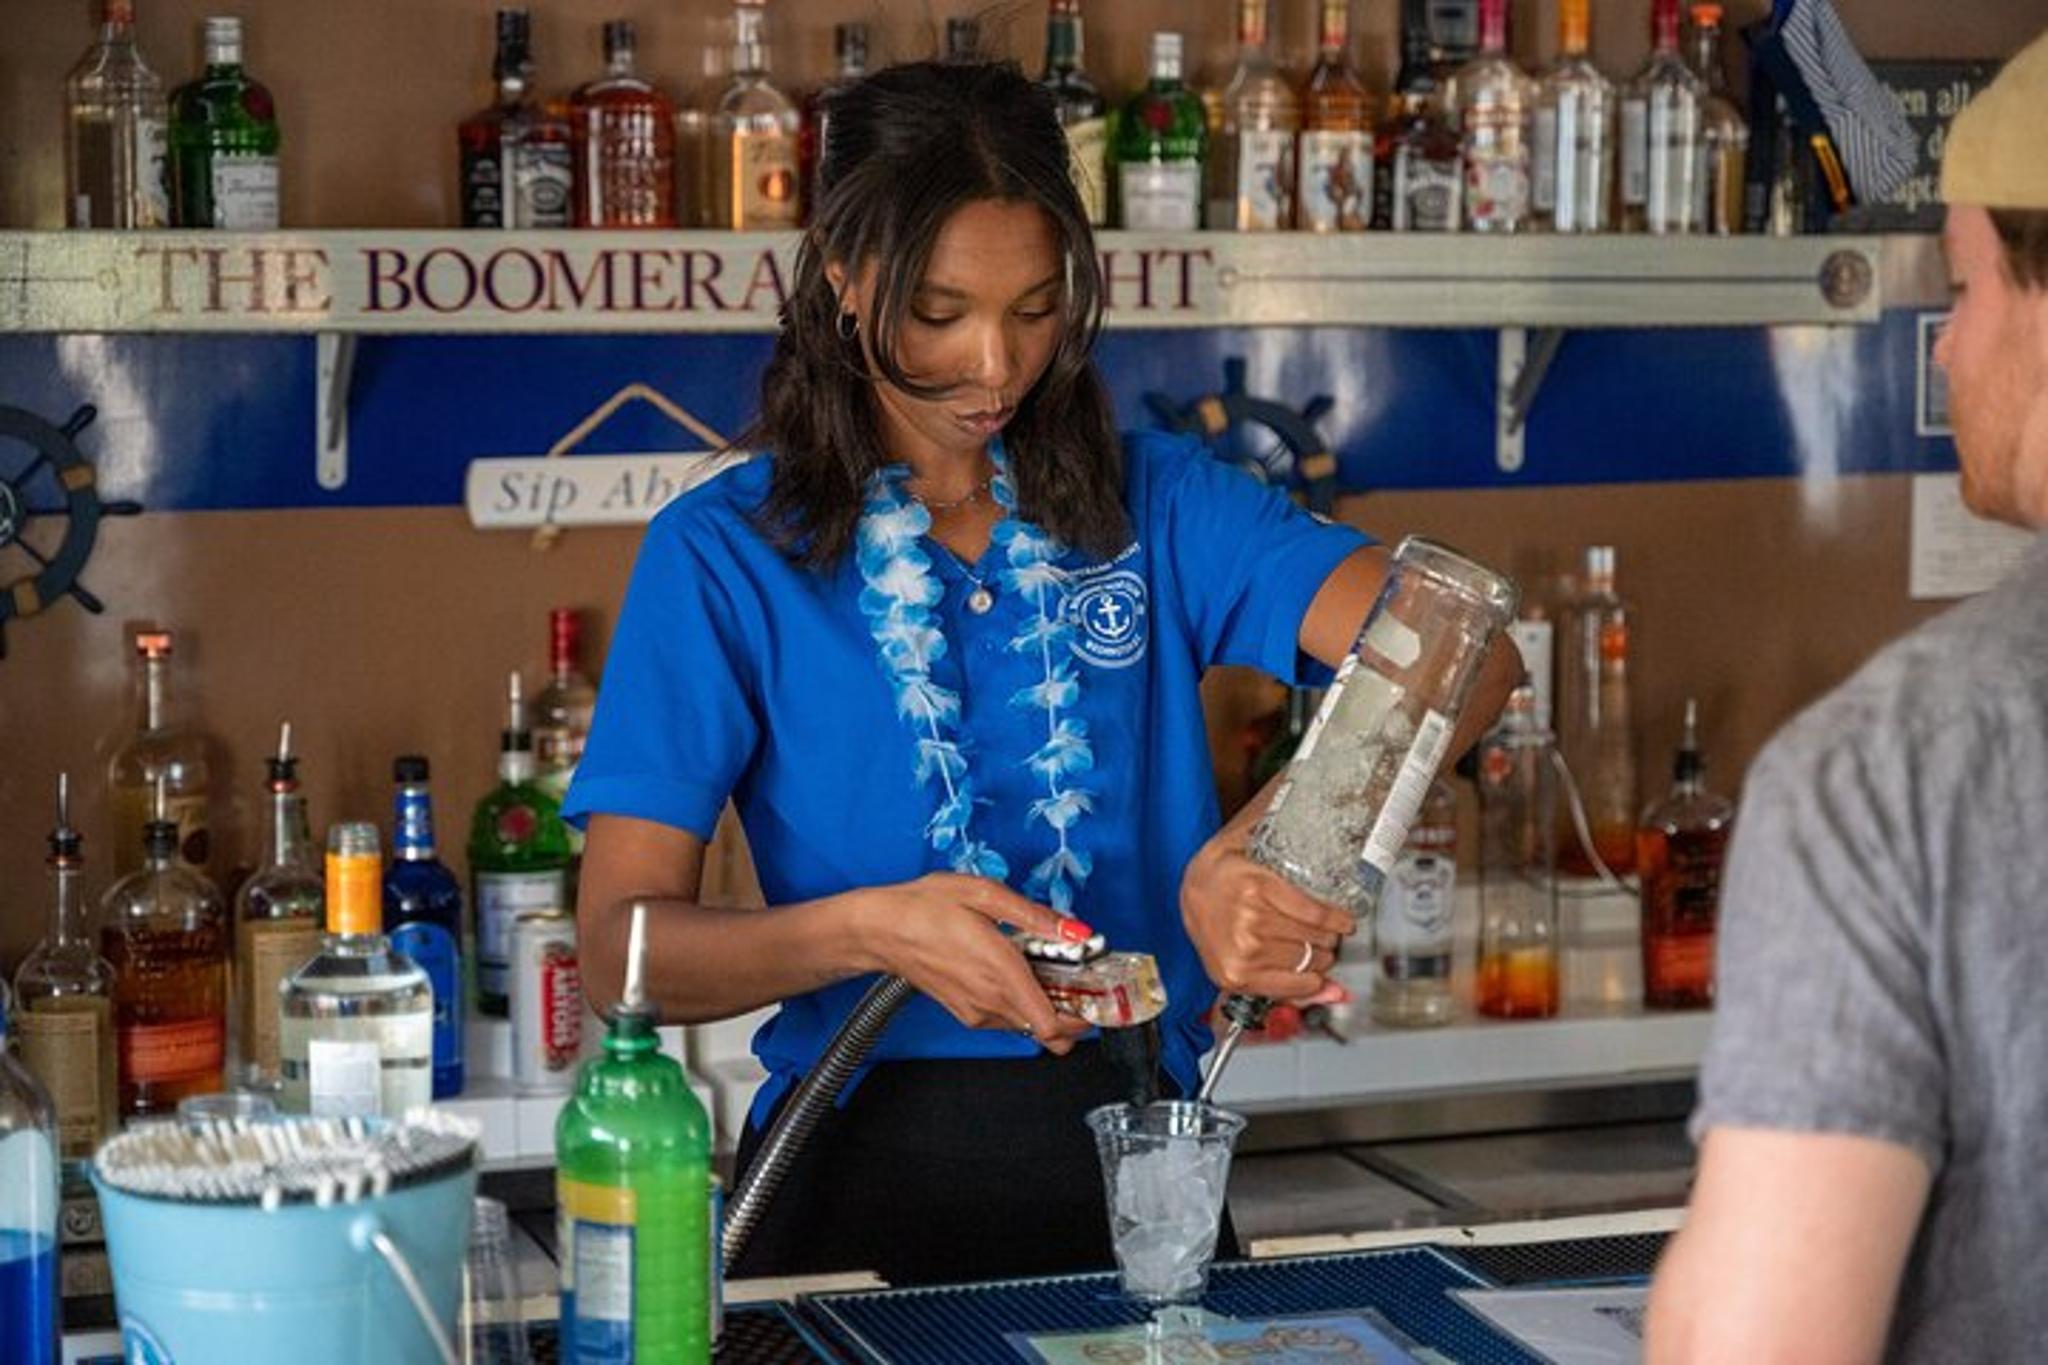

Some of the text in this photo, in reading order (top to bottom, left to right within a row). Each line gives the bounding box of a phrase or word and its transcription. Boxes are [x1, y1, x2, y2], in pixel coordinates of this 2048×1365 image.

[136, 245, 1214, 314] THE BOOMERA HT
[495, 470, 579, 523] Sip
